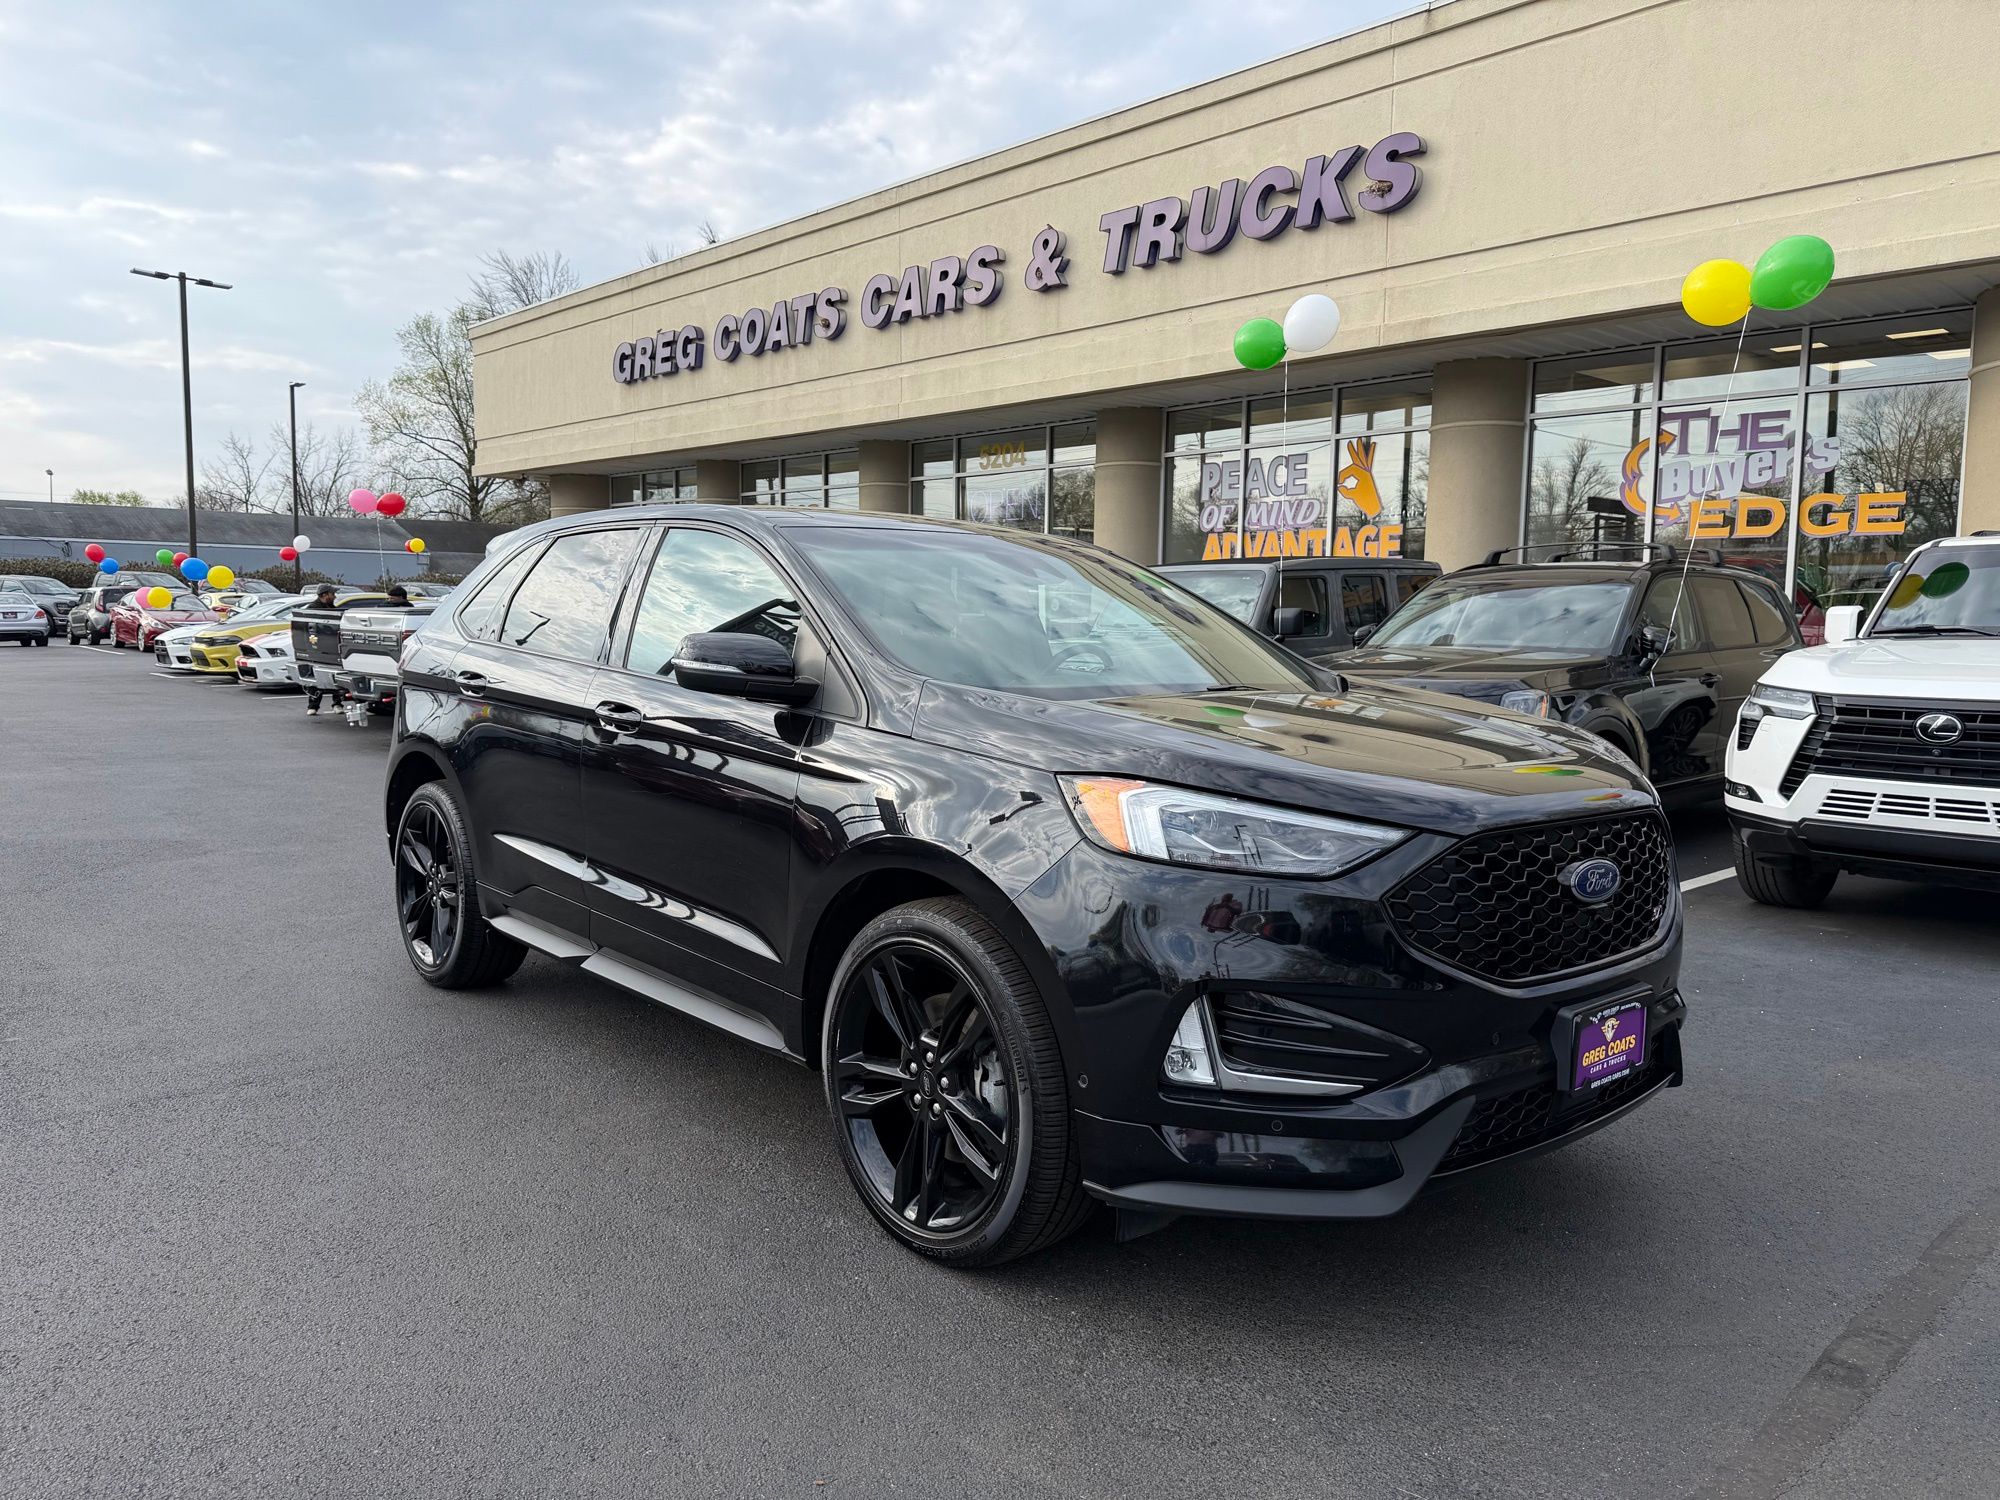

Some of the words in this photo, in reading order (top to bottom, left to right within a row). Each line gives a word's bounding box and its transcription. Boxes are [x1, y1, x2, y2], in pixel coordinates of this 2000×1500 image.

[613, 325, 705, 384] GREG
[713, 287, 848, 362] COATS
[861, 244, 1006, 330] CARS
[1025, 227, 1068, 292] &
[1099, 132, 1427, 276] TRUCKS
[1661, 407, 1791, 457] THE
[978, 441, 1026, 471] 5204
[1201, 452, 1308, 501] PEACE
[1200, 504, 1236, 533] OF
[1244, 498, 1321, 530] MIND
[1687, 490, 1908, 540] EDGE
[1201, 523, 1404, 562] ADVANTAGE
[1582, 1044, 1606, 1067] GREG
[1607, 1034, 1636, 1057] COATS
[1590, 1063, 1602, 1074] CARS
[1608, 1054, 1627, 1067] TRUCKS
